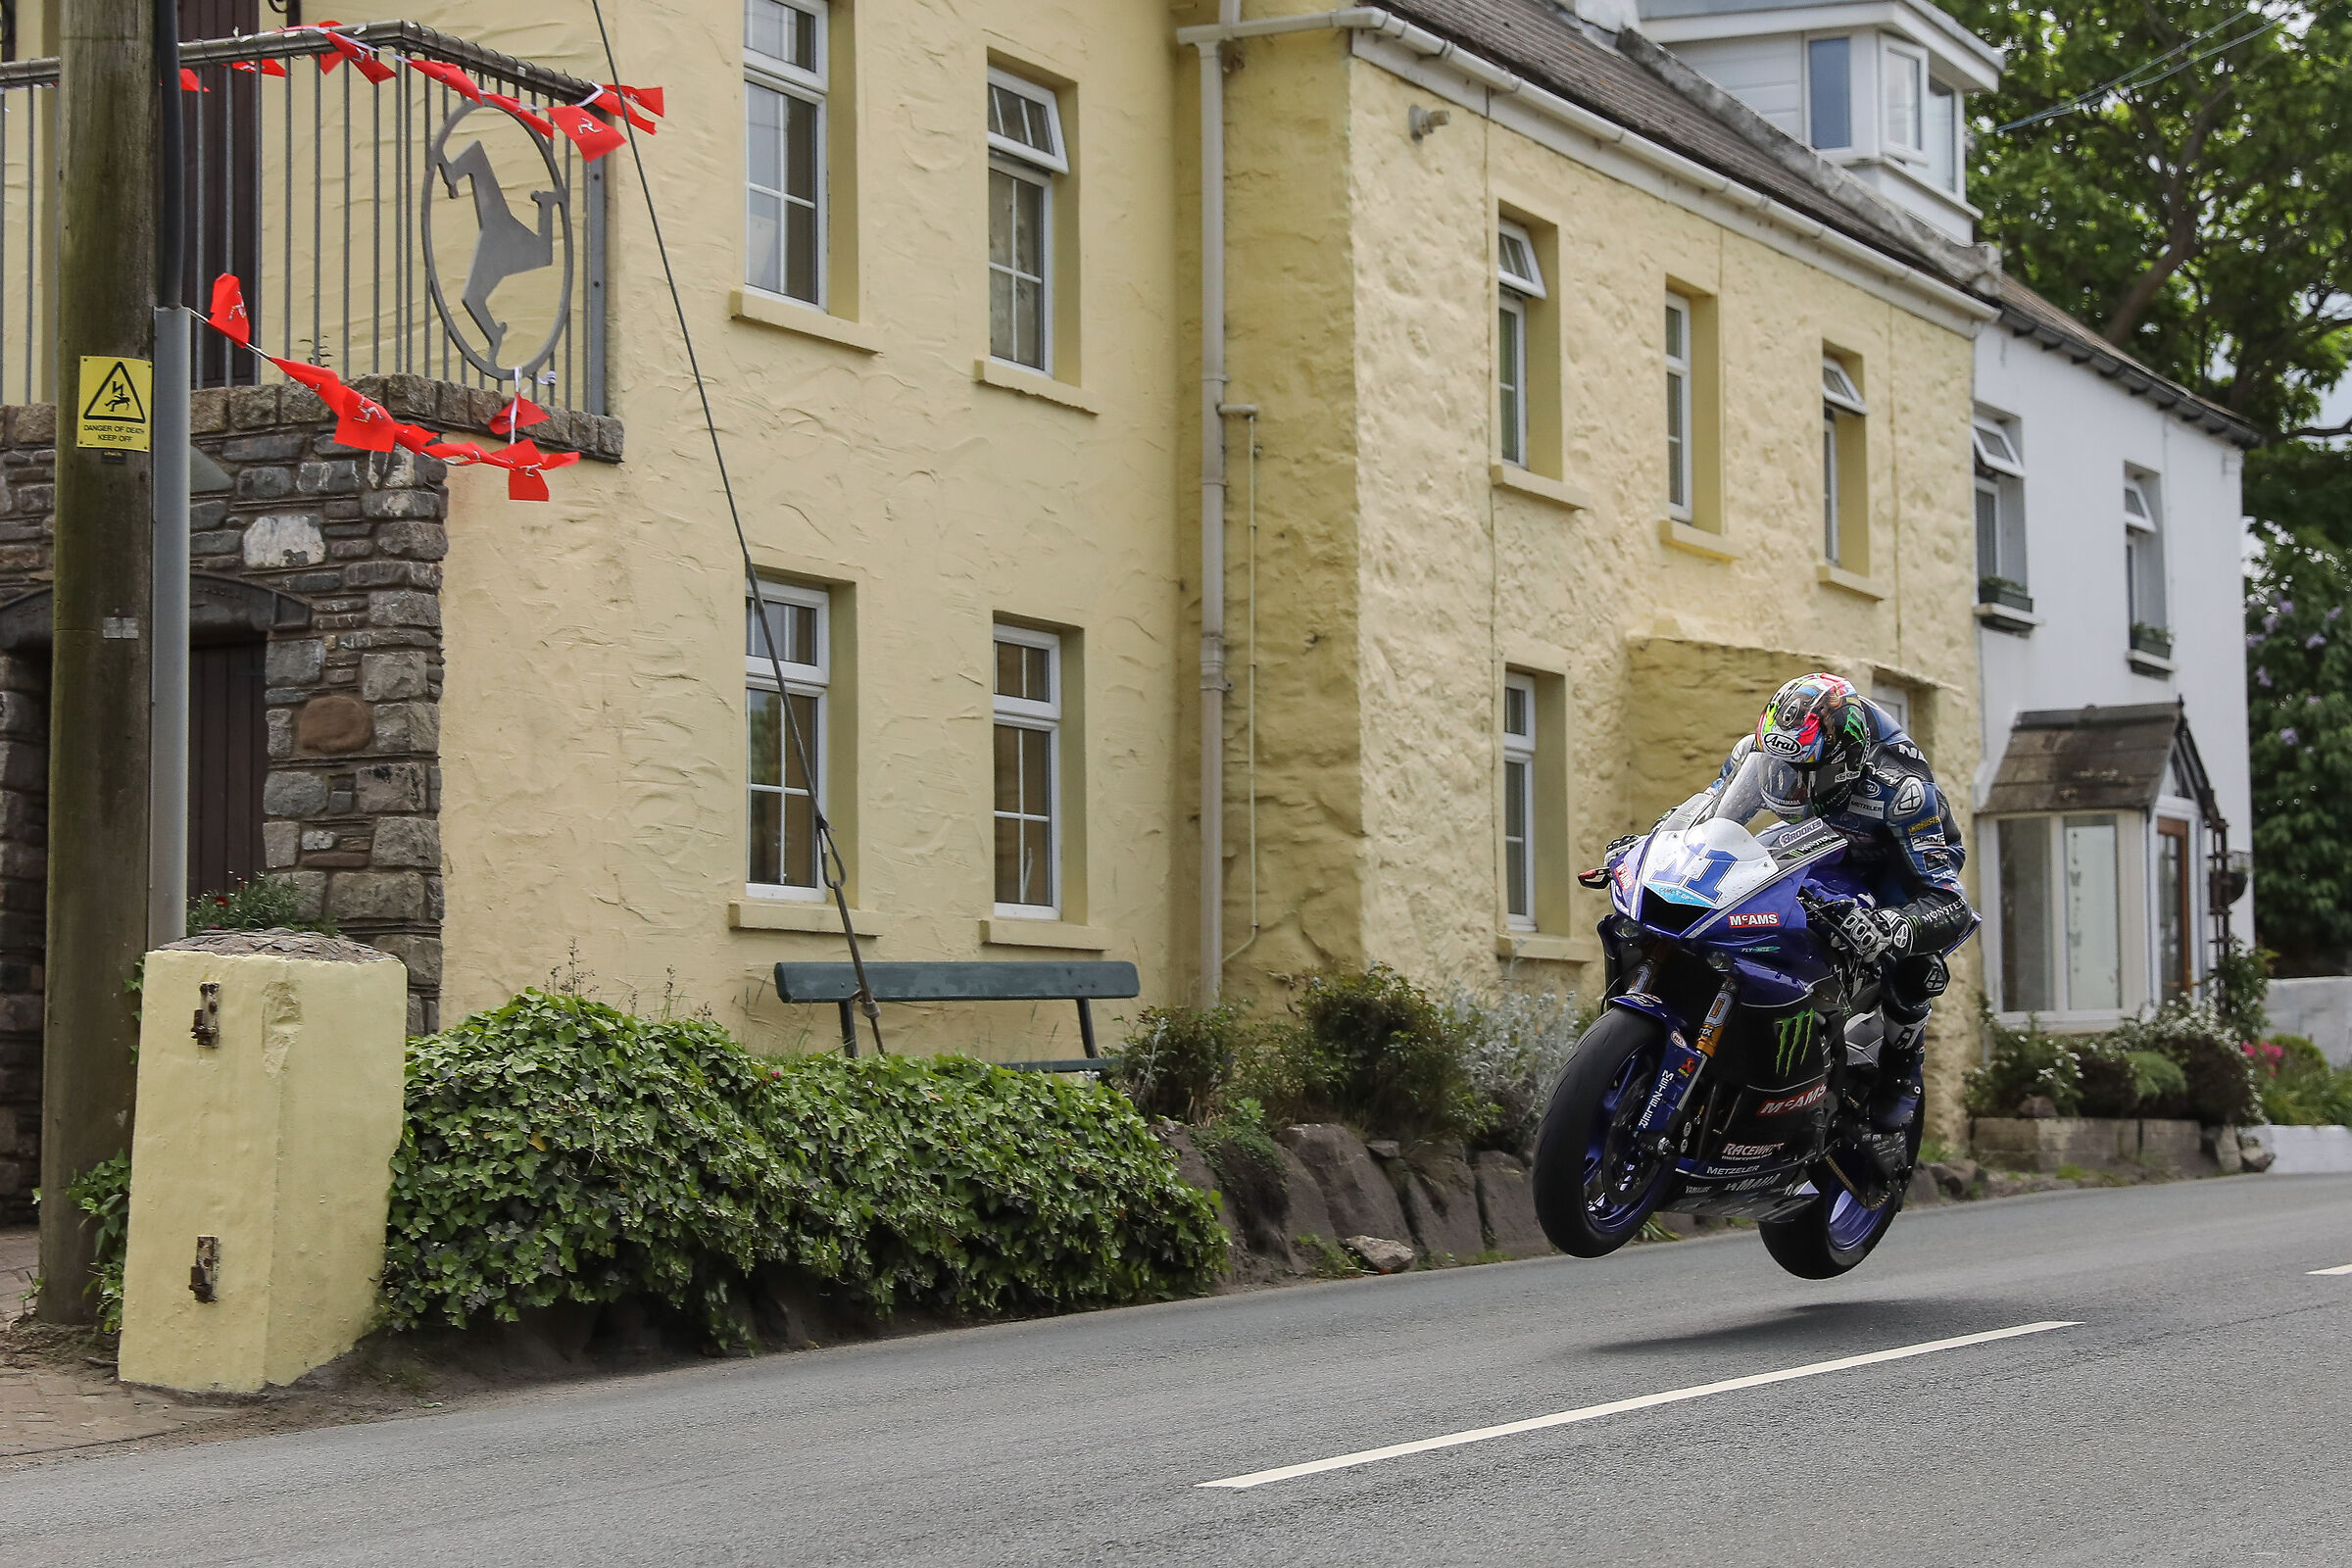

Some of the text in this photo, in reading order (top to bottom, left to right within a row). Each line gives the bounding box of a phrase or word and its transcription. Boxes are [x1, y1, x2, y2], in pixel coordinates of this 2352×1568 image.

[1766, 734, 1796, 753] Arai
[1781, 819, 1822, 844] BROOKES
[1729, 913, 1778, 926] McAMS
[1922, 897, 1967, 923] MONSTER
[1639, 1069, 1674, 1129] METZELER
[1760, 1084, 1827, 1114] McAMS
[1706, 1164, 1760, 1175] METZELER
